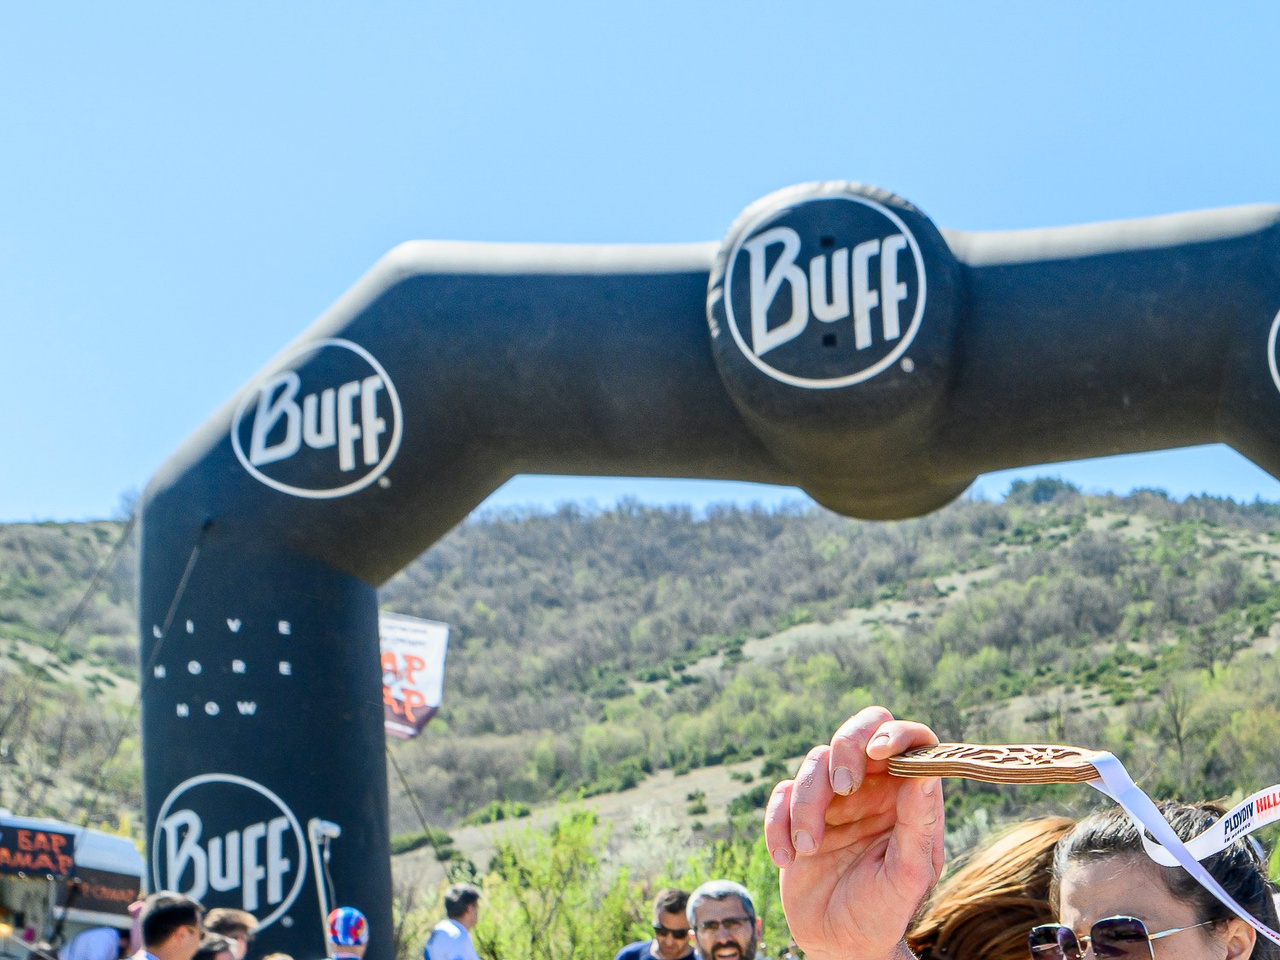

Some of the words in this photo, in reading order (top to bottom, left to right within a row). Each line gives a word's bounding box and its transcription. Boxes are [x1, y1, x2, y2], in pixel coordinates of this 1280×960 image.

[153, 618, 291, 640] LIVE
[154, 659, 292, 679] MORE
[176, 701, 257, 717] NOW
[1224, 801, 1254, 835] PLOVDIV
